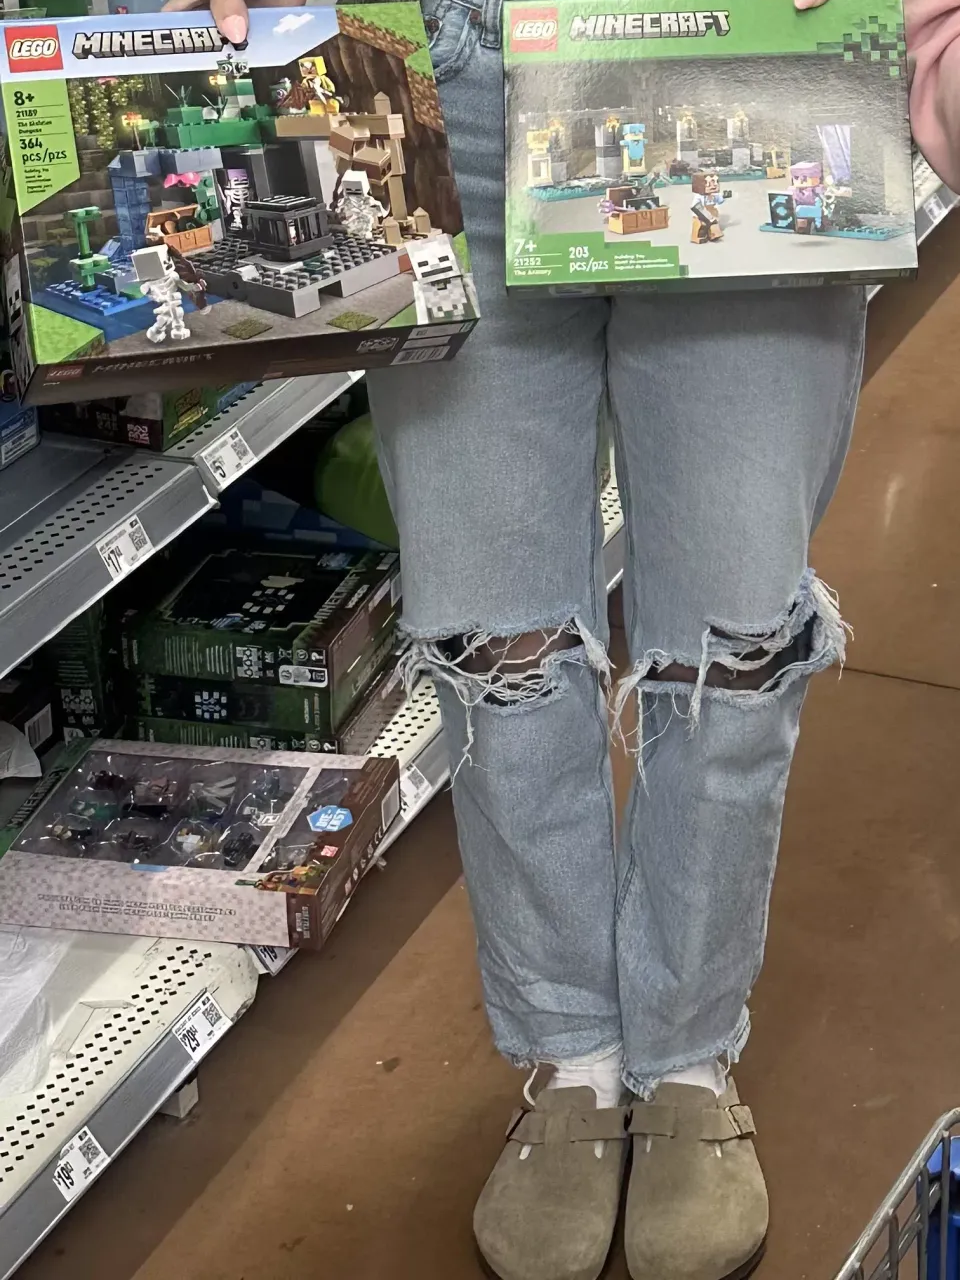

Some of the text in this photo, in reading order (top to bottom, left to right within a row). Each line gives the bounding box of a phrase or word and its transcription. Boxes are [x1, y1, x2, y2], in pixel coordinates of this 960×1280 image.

[513, 10, 731, 42] LEGO MINECRAFT
[9, 26, 248, 61] LEGO MINECRAF
[14, 90, 35, 107] 8+
[19, 137, 43, 150] 364
[22, 147, 67, 165] pcs/pzs
[513, 238, 537, 255] 7+
[569, 246, 589, 259] 203
[569, 257, 609, 274] pcs/pzs
